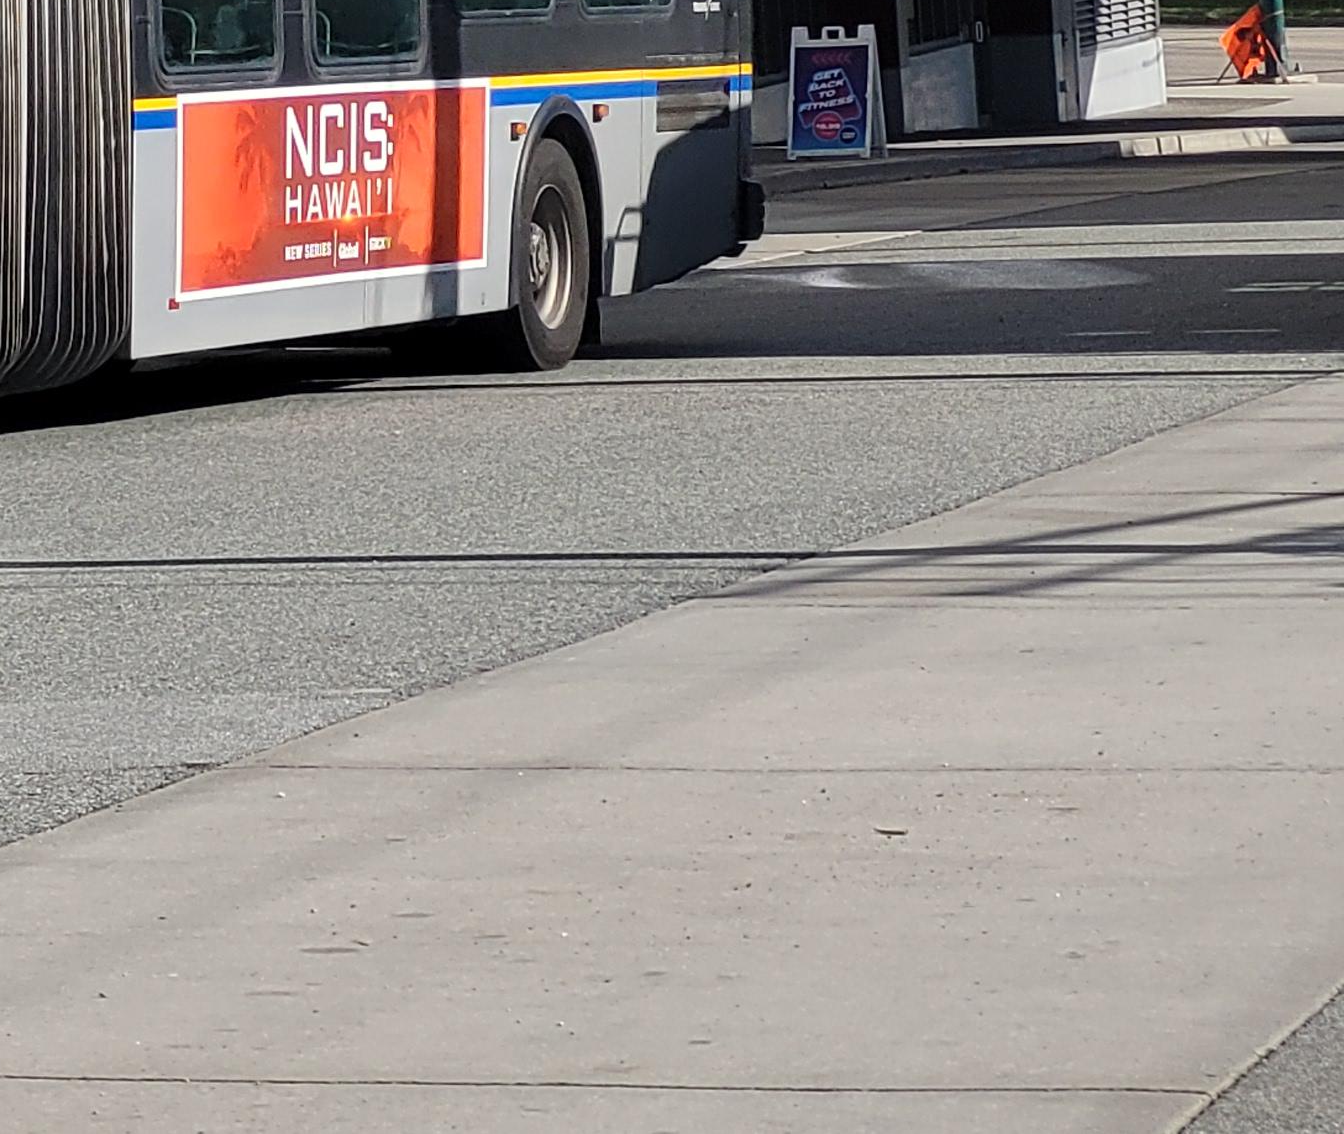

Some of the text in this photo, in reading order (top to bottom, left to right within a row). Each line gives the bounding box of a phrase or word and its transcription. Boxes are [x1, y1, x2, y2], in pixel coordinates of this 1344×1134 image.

[813, 68, 840, 81] GET
[818, 90, 836, 98] TO
[799, 96, 854, 112] FITNESS
[285, 101, 393, 179] NCIS:
[285, 177, 392, 225] HAWAI'I
[304, 241, 332, 259] SERIES
